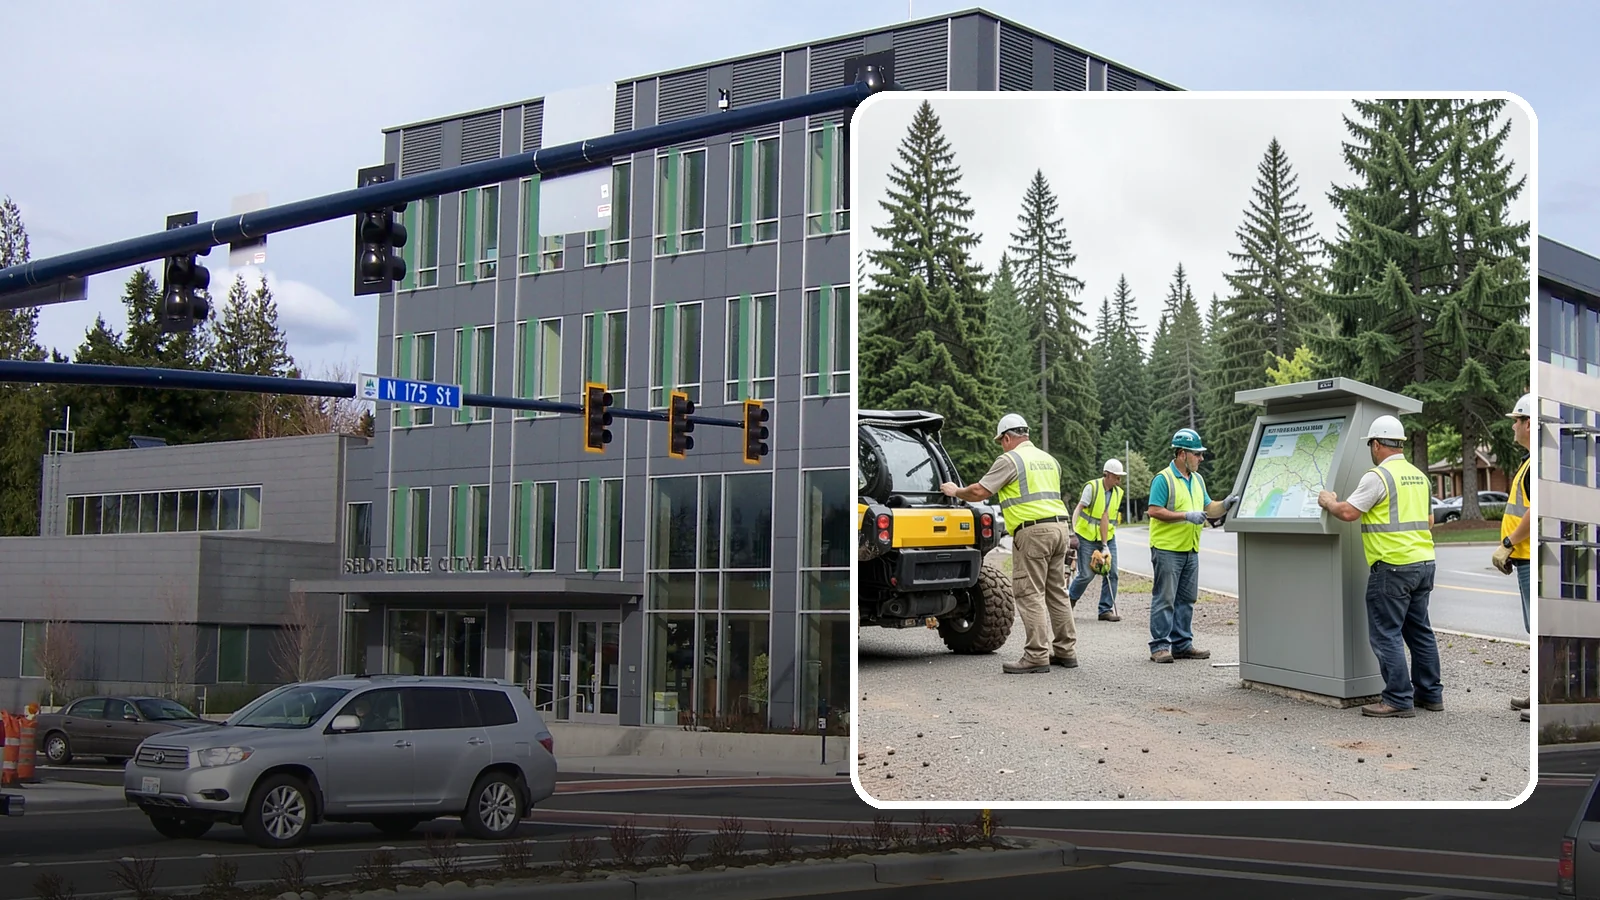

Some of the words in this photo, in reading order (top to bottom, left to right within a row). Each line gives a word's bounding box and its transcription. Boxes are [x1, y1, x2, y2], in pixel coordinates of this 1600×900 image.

[387, 380, 396, 400] N
[405, 382, 427, 403] 175
[436, 386, 451, 406] St
[344, 556, 432, 574] SHORELINE
[438, 556, 475, 573] CITY
[483, 555, 525, 572] HALL
